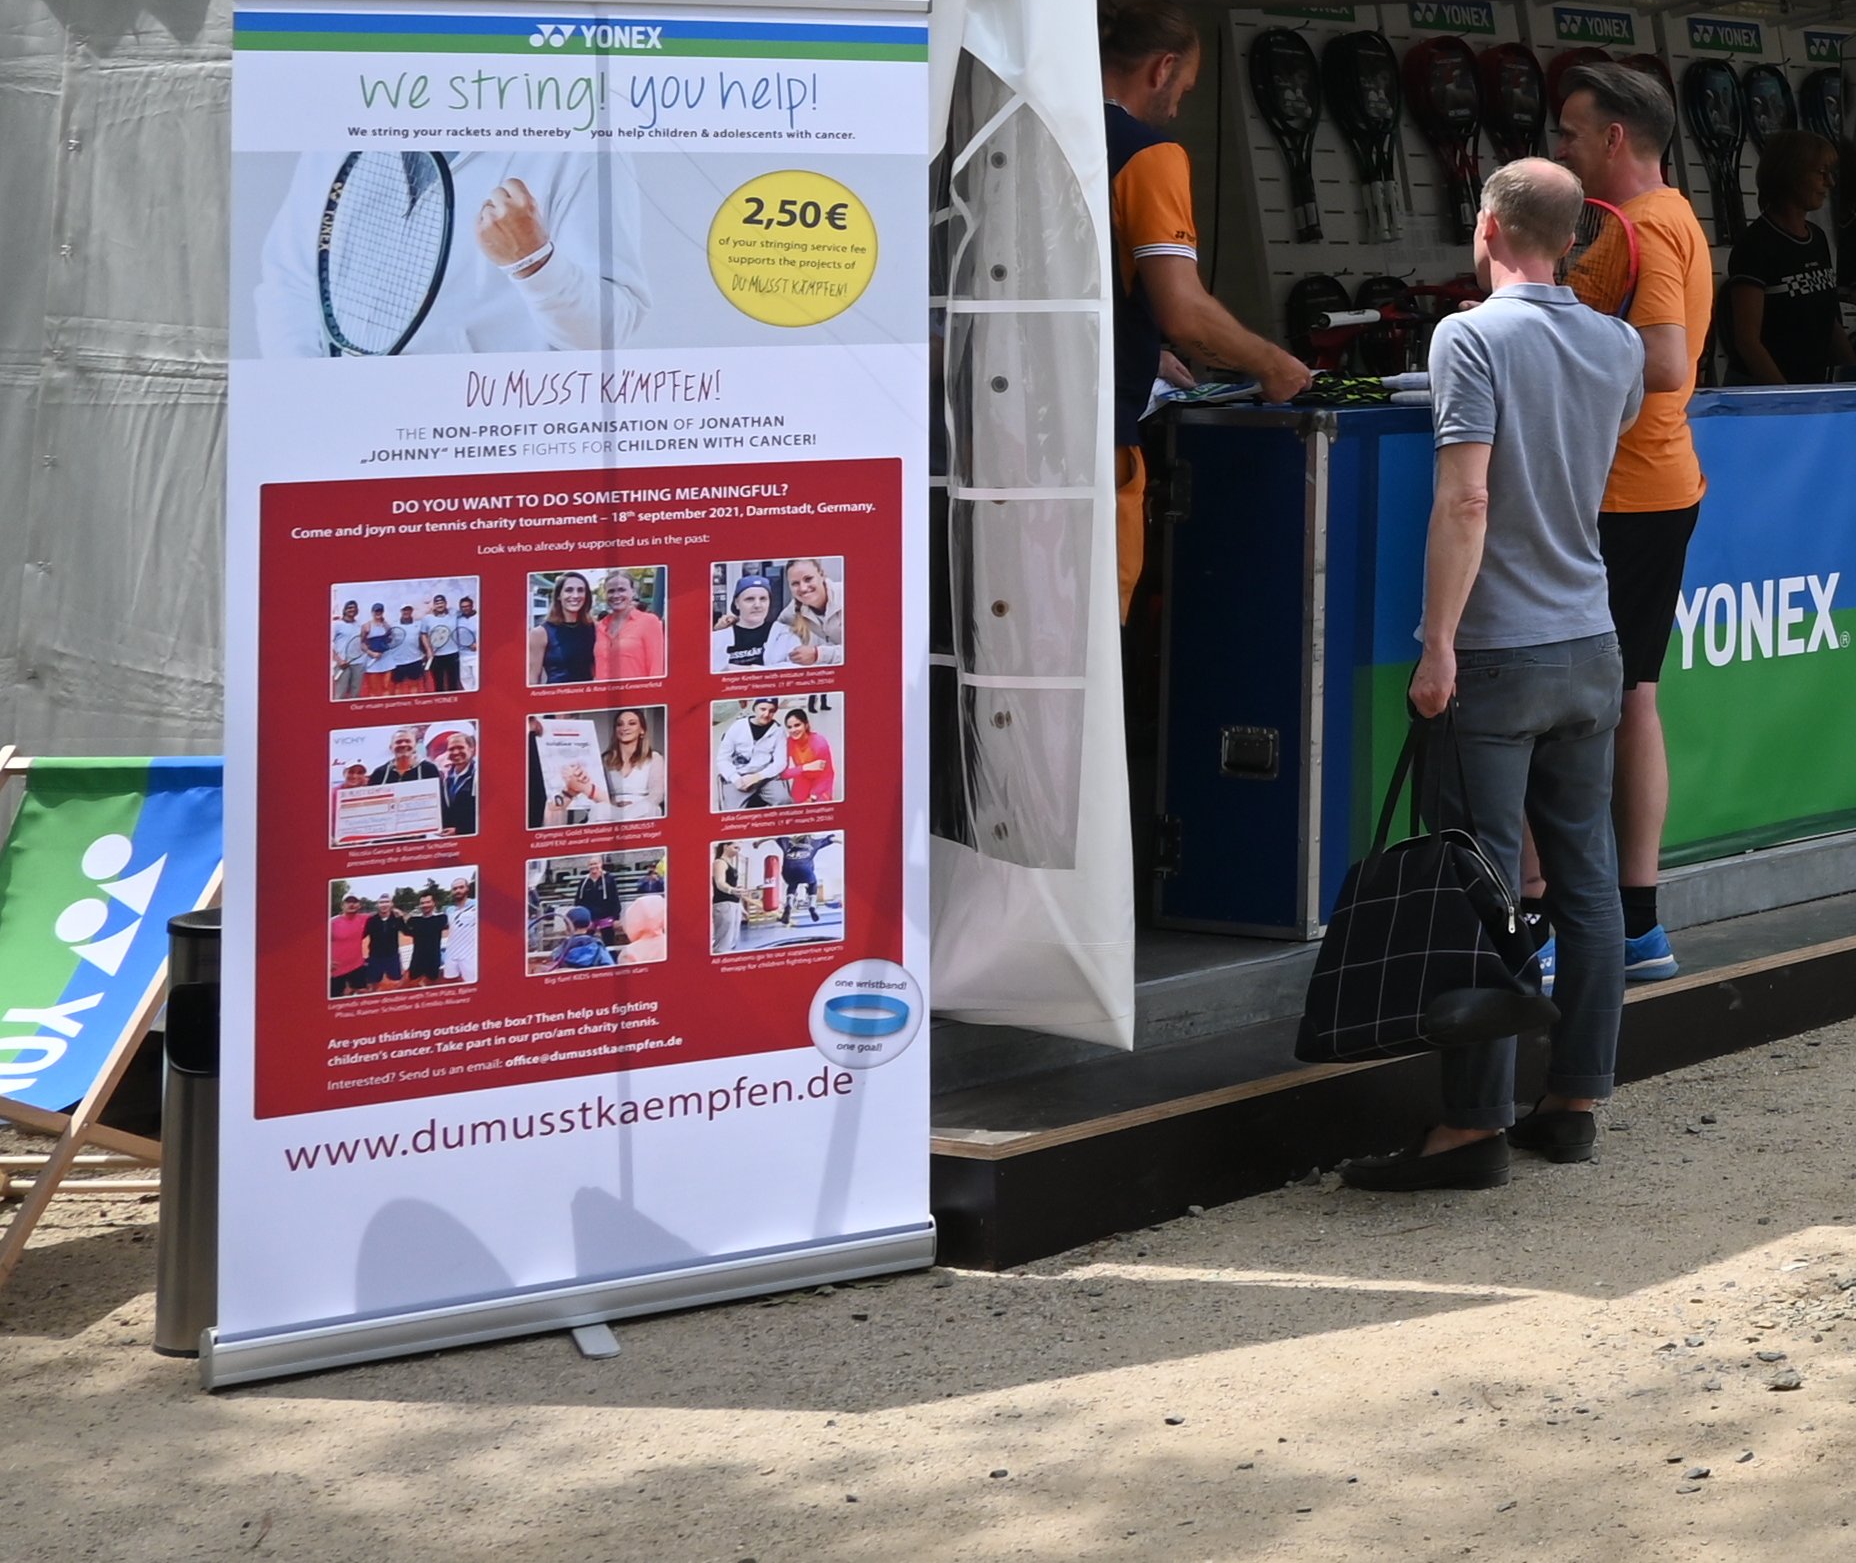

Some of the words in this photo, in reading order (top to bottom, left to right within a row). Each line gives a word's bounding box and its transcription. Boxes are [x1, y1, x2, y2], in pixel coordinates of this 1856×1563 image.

[1442, 4, 1491, 28] YONEX
[1584, 13, 1630, 38] YONEX
[581, 26, 662, 49] YONEX
[1717, 25, 1759, 49] YONEX
[360, 71, 430, 109] We
[448, 69, 605, 131] string!
[630, 75, 705, 129] you
[720, 72, 817, 129] help!
[348, 127, 368, 136] We
[372, 127, 409, 138] string
[413, 128, 442, 138] your
[446, 127, 491, 137] rackets
[495, 127, 518, 136] and
[523, 127, 571, 139] thereby
[591, 129, 613, 139] you
[618, 128, 644, 139] help
[648, 128, 698, 138] children
[701, 129, 709, 138] &
[713, 129, 783, 139] adolescents
[786, 130, 812, 140] with
[815, 132, 855, 140] cancer.
[718, 237, 730, 245] of
[732, 239, 756, 247] your
[760, 240, 808, 252] stringing
[811, 244, 847, 253] service
[850, 244, 866, 254] fee
[728, 255, 775, 265] supports
[779, 257, 796, 266] the
[800, 260, 841, 269] projects
[844, 261, 856, 270] of
[732, 274, 747, 292] DU
[749, 275, 788, 294] MUSST
[466, 371, 496, 407] DU
[503, 369, 592, 408] MUSST
[601, 369, 721, 404] KÄMPFEN!
[396, 427, 427, 441] THE
[432, 423, 538, 439] NON-PROFIT
[543, 418, 668, 435] ORGANISATION
[673, 418, 694, 430] OF
[699, 416, 785, 430] JONATHAN
[454, 445, 517, 458] HEIMES
[523, 441, 576, 456] FIGHTS
[582, 441, 613, 453] FOR
[618, 438, 698, 452] CHILDREN
[704, 436, 744, 449] WITH
[750, 434, 816, 447] CANCER!
[392, 500, 419, 514] DO
[423, 499, 458, 513] YOU
[463, 496, 513, 511] WANT
[516, 494, 538, 508] TO
[543, 492, 569, 507] DO
[573, 488, 672, 505] SOMETHING
[676, 484, 788, 500] MEANINGFUL?
[291, 527, 332, 539] Come
[335, 525, 362, 537] and
[364, 524, 396, 538] joyn
[399, 524, 422, 533] our
[426, 519, 467, 532] tennis
[470, 517, 516, 531] charity
[519, 514, 598, 527] tournament
[638, 508, 706, 524] september
[709, 507, 744, 518] 2021,
[746, 503, 814, 517] Darmstadt,
[818, 502, 876, 514] Germany.
[478, 544, 504, 554] Look
[507, 542, 532, 552] who
[534, 540, 575, 552] already
[578, 537, 634, 549] supported
[637, 538, 649, 546] us
[652, 536, 662, 545] in
[664, 535, 681, 544] the
[684, 534, 710, 545] past:
[1675, 572, 1840, 670] YONEX
[856, 980, 907, 990] wristband!
[328, 1039, 350, 1049] Are
[352, 1037, 377, 1048] you
[379, 1029, 431, 1043] thinking
[433, 1022, 480, 1036] outside
[482, 1019, 502, 1029] the
[505, 1014, 532, 1028] box?
[535, 1013, 565, 1024] Then
[567, 1009, 593, 1021] help
[596, 1007, 609, 1016] us
[612, 1001, 658, 1015] fighting
[390, 1046, 434, 1059] cancer.
[436, 1040, 464, 1052] Take
[466, 1037, 492, 1051] part
[494, 1036, 506, 1045] in
[508, 1034, 529, 1044] our
[532, 1027, 575, 1043] pro/am
[578, 1021, 618, 1035] charity
[621, 1017, 659, 1029] tennis.
[837, 1043, 855, 1051] one
[858, 1043, 882, 1053] goal!
[328, 1073, 395, 1091] Interested?
[399, 1068, 429, 1082] Send
[433, 1067, 446, 1077] us
[449, 1065, 464, 1075] an
[467, 1059, 502, 1072] email:
[505, 1036, 683, 1068] office@dumusstkaempfen.de
[284, 1065, 854, 1172] www.dumusstkaempfen.de
